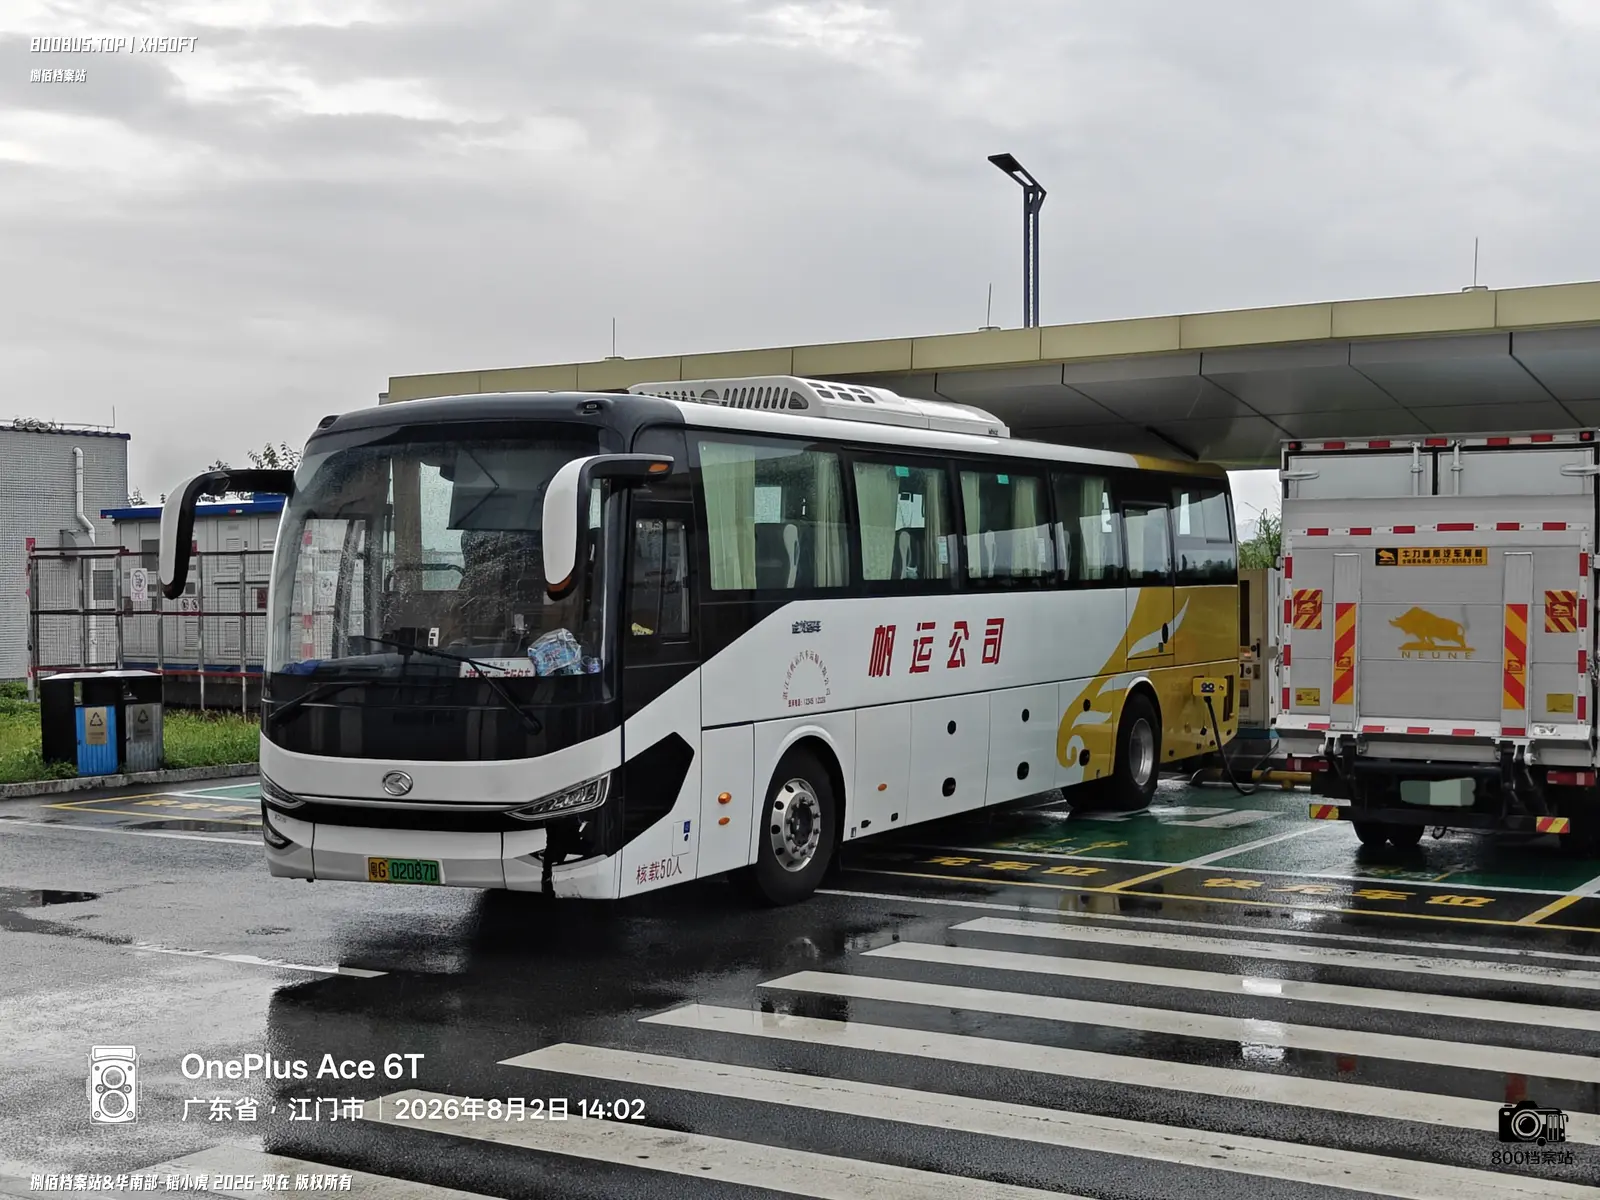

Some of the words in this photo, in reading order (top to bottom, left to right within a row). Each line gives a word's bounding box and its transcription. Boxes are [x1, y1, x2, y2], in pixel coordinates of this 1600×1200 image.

[868, 617, 1005, 678] 帆运公司
[1401, 650, 1472, 660] NEUNE
[636, 856, 682, 885] 核载50人
